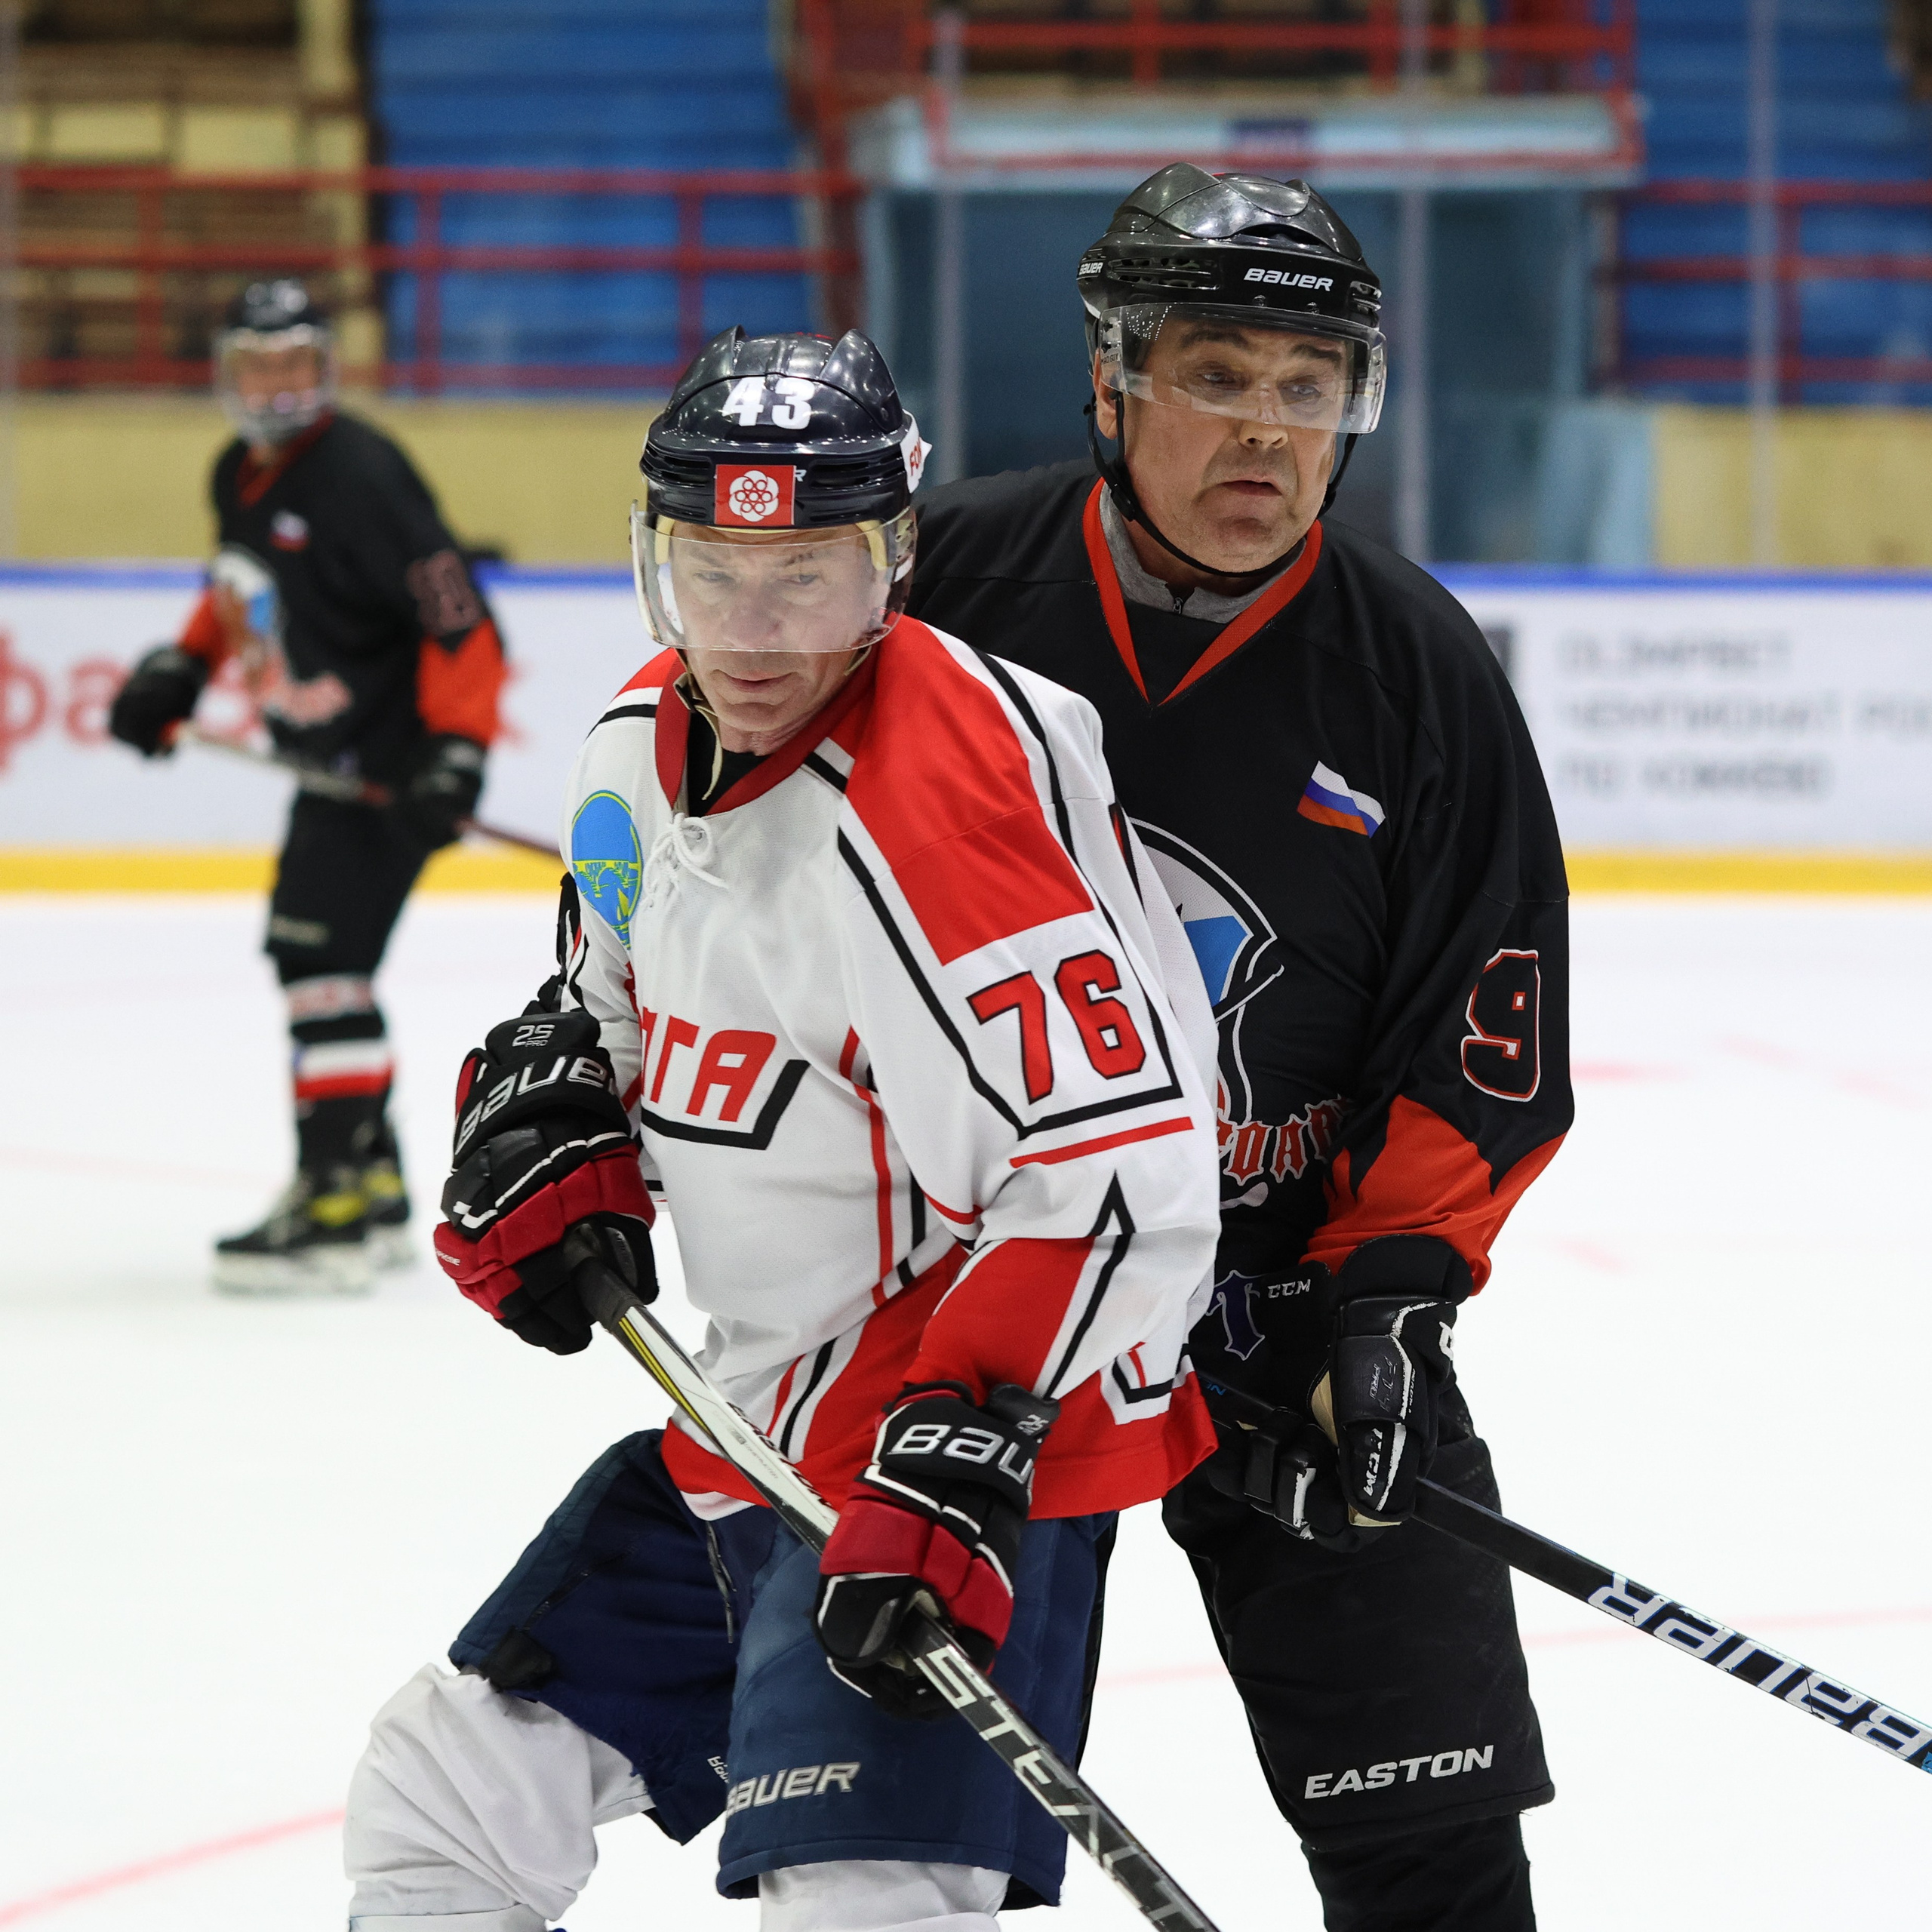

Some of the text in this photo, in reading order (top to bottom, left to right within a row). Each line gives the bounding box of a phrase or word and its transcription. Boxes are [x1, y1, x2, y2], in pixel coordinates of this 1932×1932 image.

[1243, 268, 1334, 291] BAUER
[721, 377, 816, 429] 43
[966, 949, 1146, 1105] 76
[1460, 949, 1540, 1102] 9
[454, 1055, 616, 1155] BAUE
[1268, 1279, 1311, 1299] CCM
[887, 1423, 1035, 1502] BAU
[1586, 1572, 1932, 1761] BAUER
[913, 1644, 1212, 1932] STEALT
[1304, 1745, 1494, 1799] EASTON
